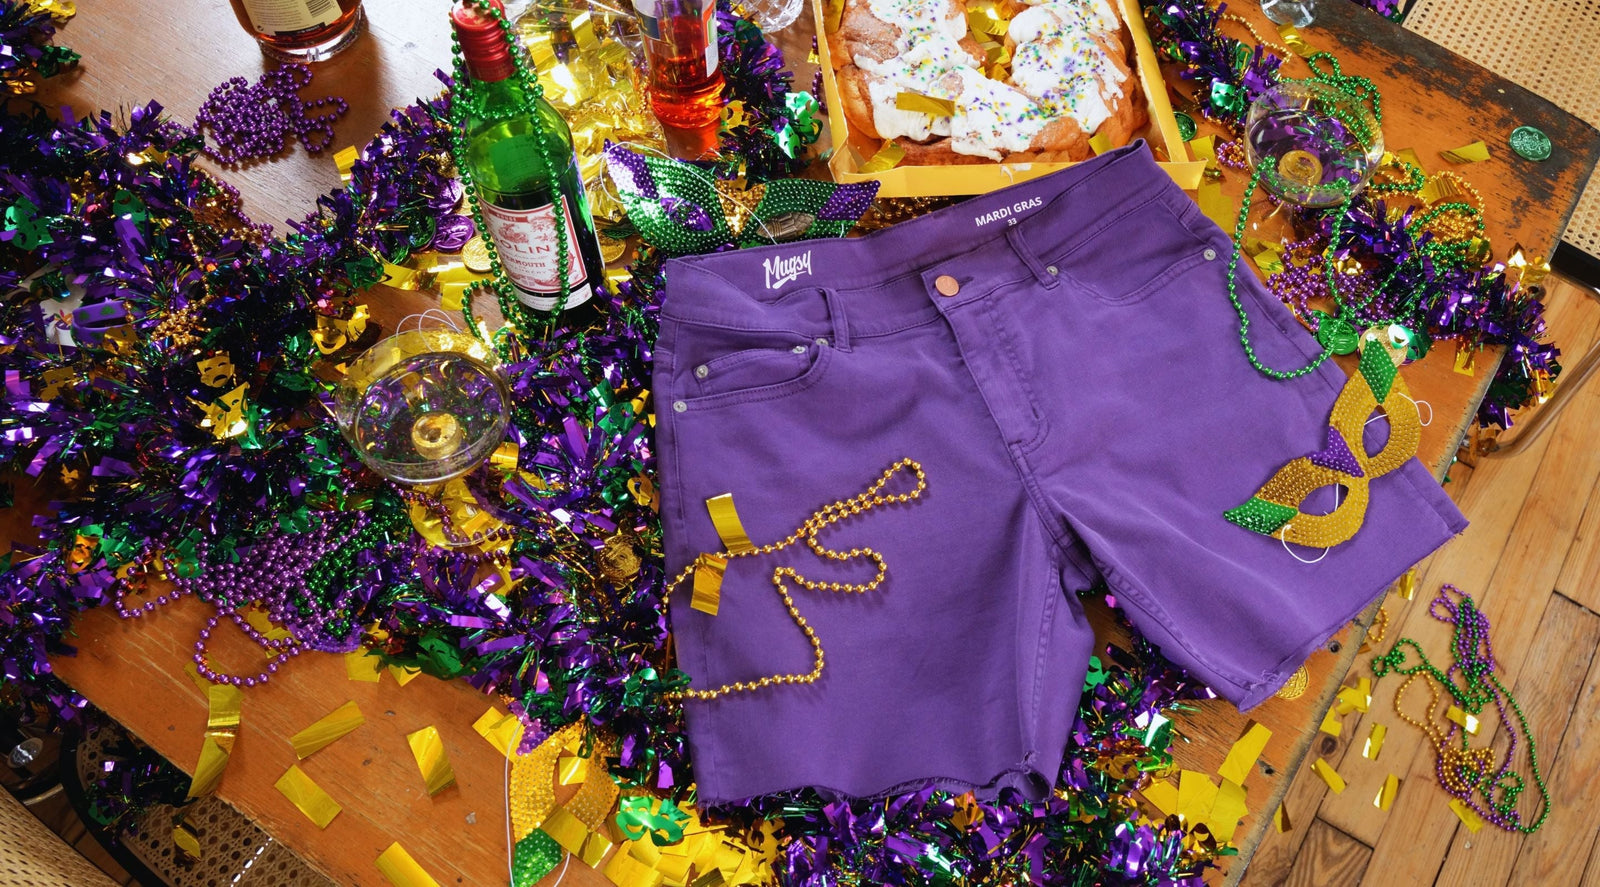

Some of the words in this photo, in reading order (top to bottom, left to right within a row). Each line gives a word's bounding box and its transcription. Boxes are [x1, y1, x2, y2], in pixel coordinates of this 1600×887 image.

[974, 206, 1012, 227] MARDI
[1013, 196, 1043, 213] GRAS
[1007, 217, 1017, 227] 33
[495, 236, 550, 254] OLIN
[762, 250, 812, 290] Mugsy
